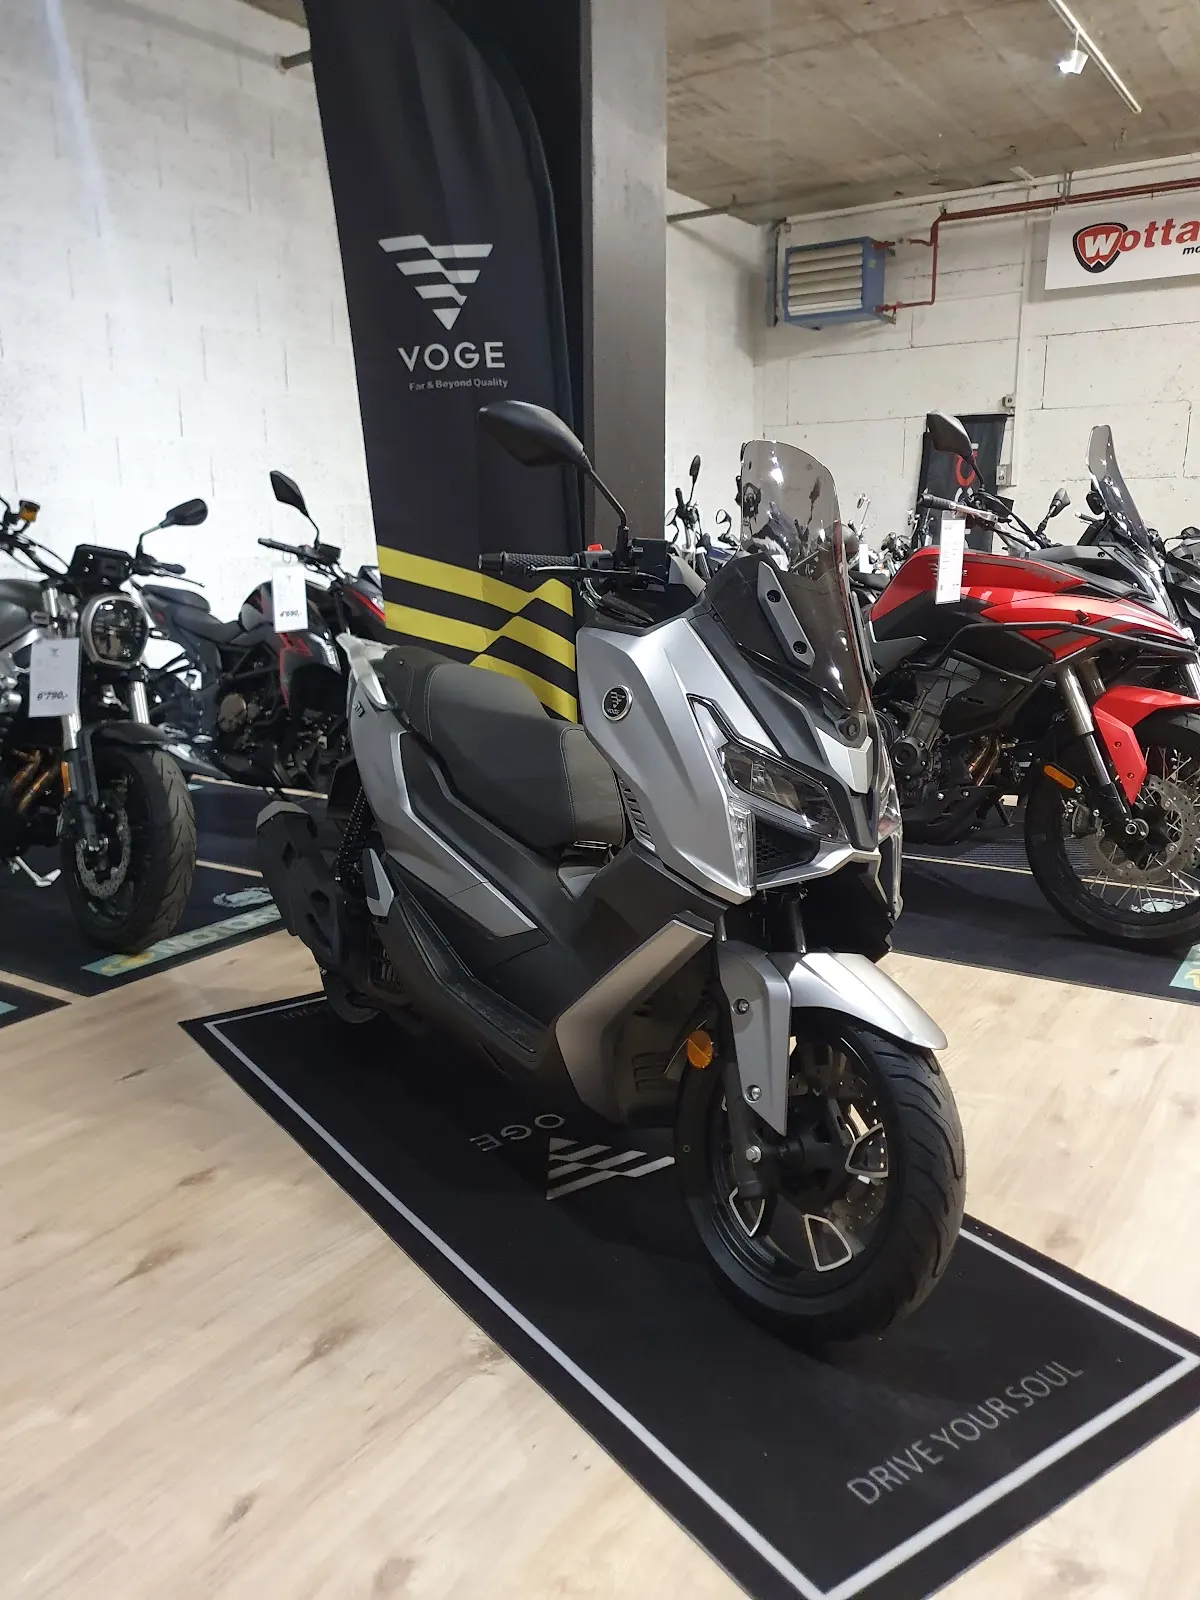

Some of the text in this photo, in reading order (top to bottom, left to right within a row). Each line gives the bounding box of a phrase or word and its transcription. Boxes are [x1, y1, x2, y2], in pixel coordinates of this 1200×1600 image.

[1084, 218, 1200, 259] Wotta
[397, 341, 506, 373] VOGE
[408, 378, 508, 391] Far & Beyond Quality
[469, 1113, 565, 1152] OGE
[846, 1361, 1084, 1505] DRIVE YOUR SOUL
